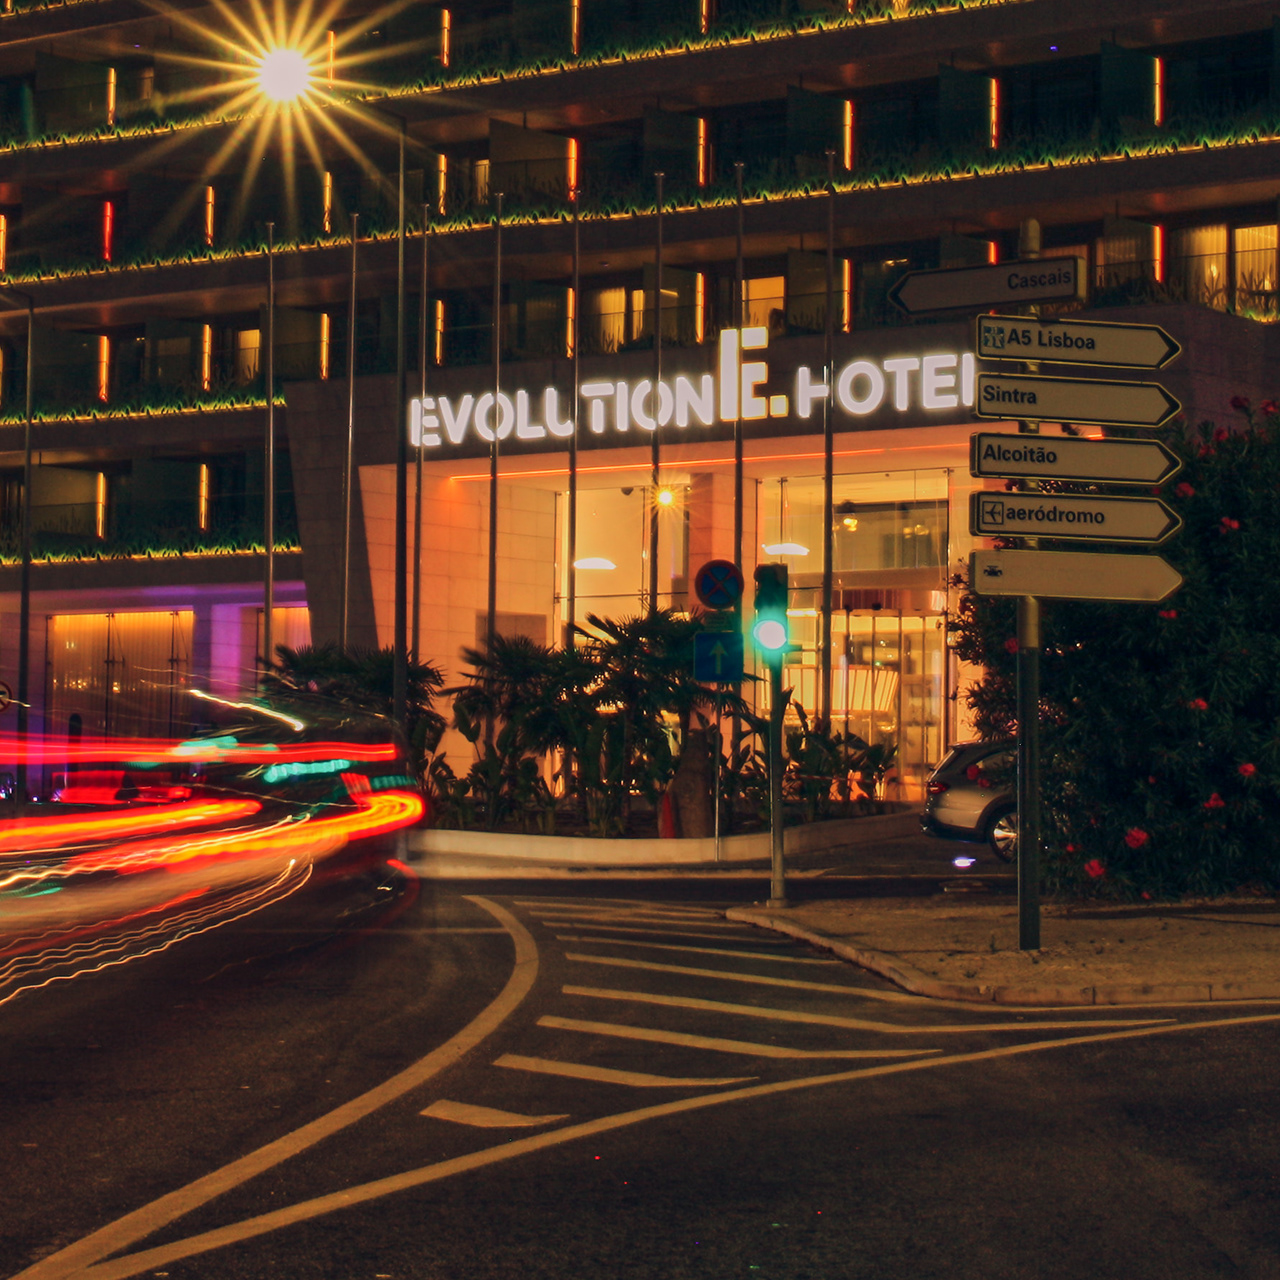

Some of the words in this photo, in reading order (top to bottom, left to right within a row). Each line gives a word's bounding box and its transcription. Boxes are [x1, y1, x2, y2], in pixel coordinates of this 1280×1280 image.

[1007, 270, 1071, 290] Cascais
[1007, 328, 1032, 346] A5
[1038, 329, 1096, 351] Lisboa
[982, 385, 1037, 405] Sintra
[982, 443, 1058, 465] Alcoitão
[1005, 505, 1105, 525] aeródromo
